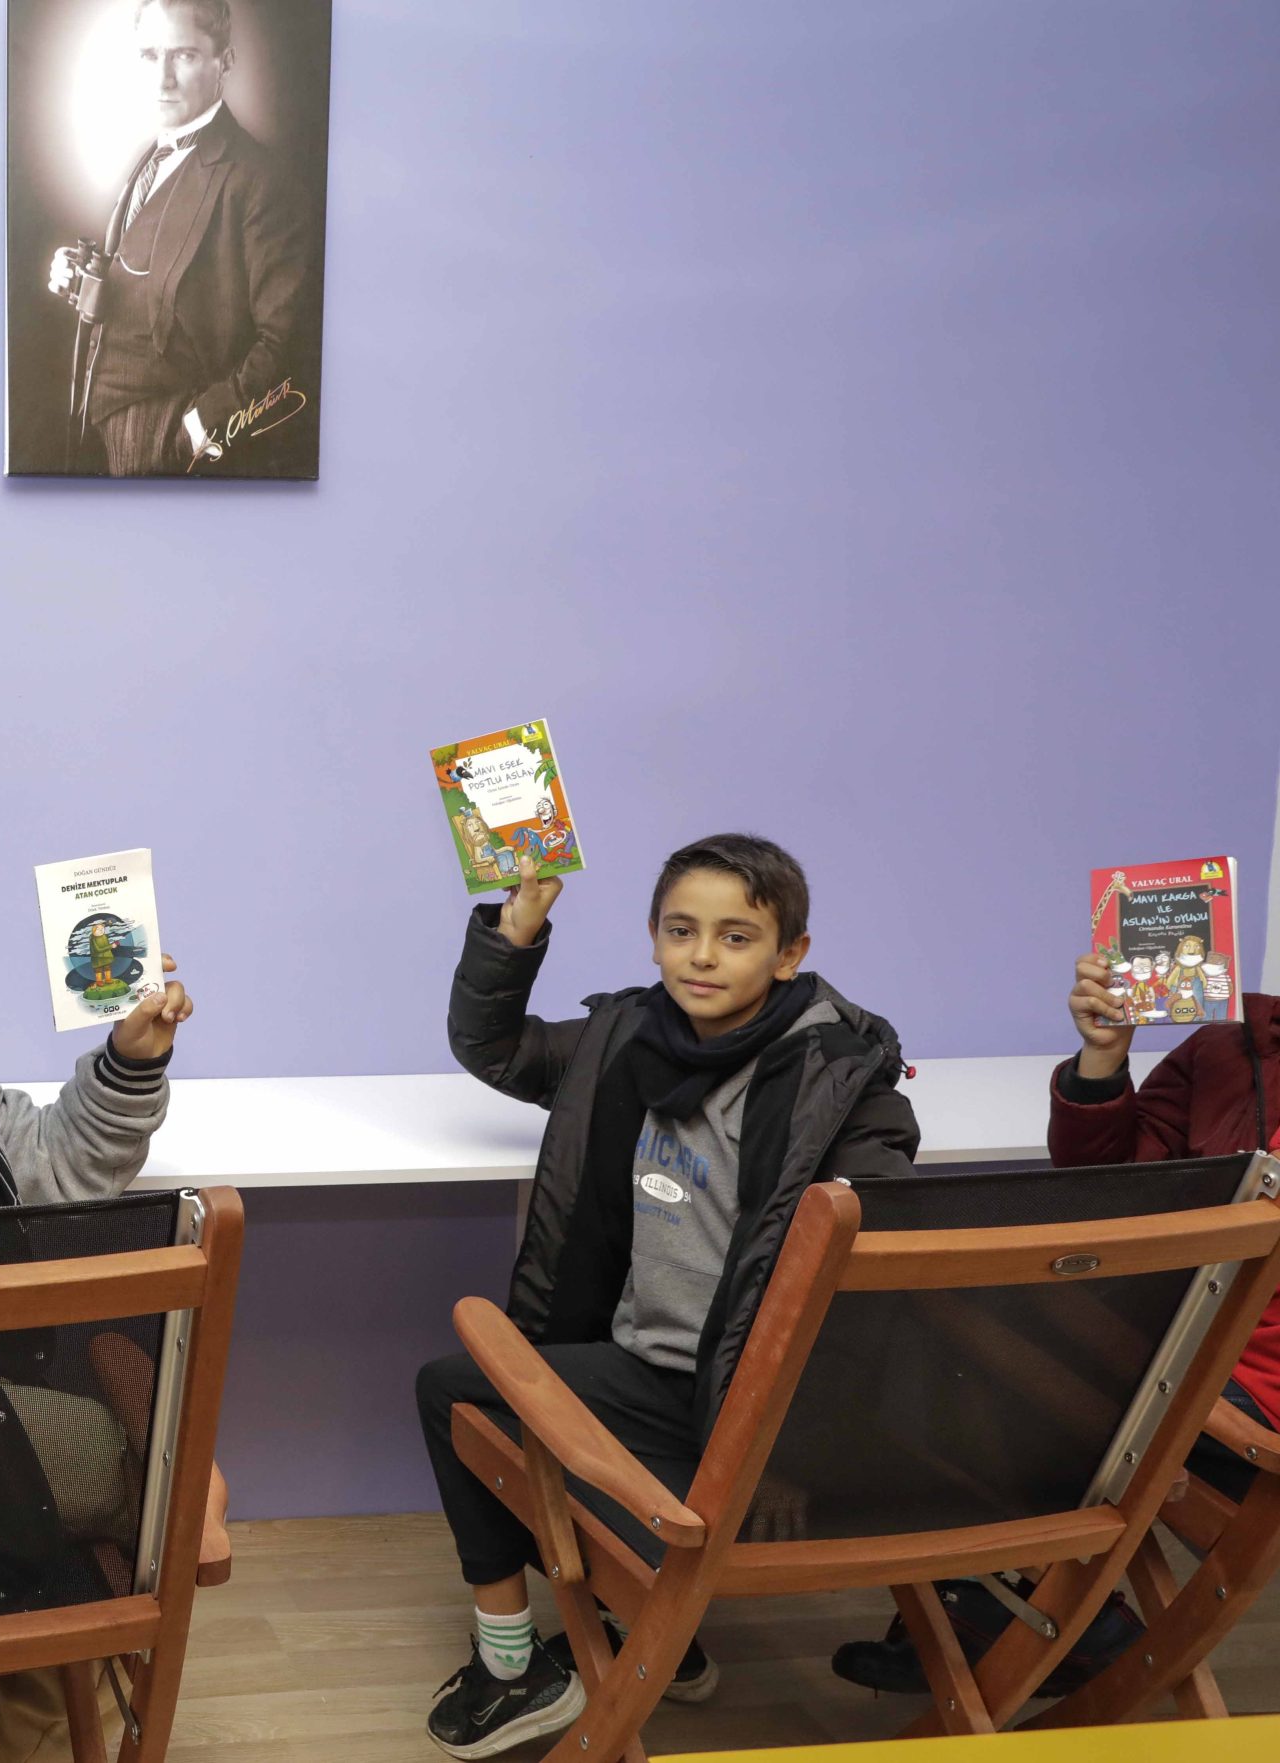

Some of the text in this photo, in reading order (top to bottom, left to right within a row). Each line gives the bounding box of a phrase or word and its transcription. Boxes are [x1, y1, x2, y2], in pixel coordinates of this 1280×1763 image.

[468, 776, 502, 790] POSTLU
[506, 767, 534, 781] ASLAN
[61, 876, 128, 893] DENİZE MEKTUPLAR
[1132, 875, 1193, 887] YALVAÇ URAL
[75, 887, 118, 900] ATAN ÇOCUK
[1162, 890, 1197, 902] KARGA
[1174, 912, 1208, 923] OYUNU
[637, 1126, 709, 1190] HICAGO
[645, 1177, 678, 1199] ILLINOIS
